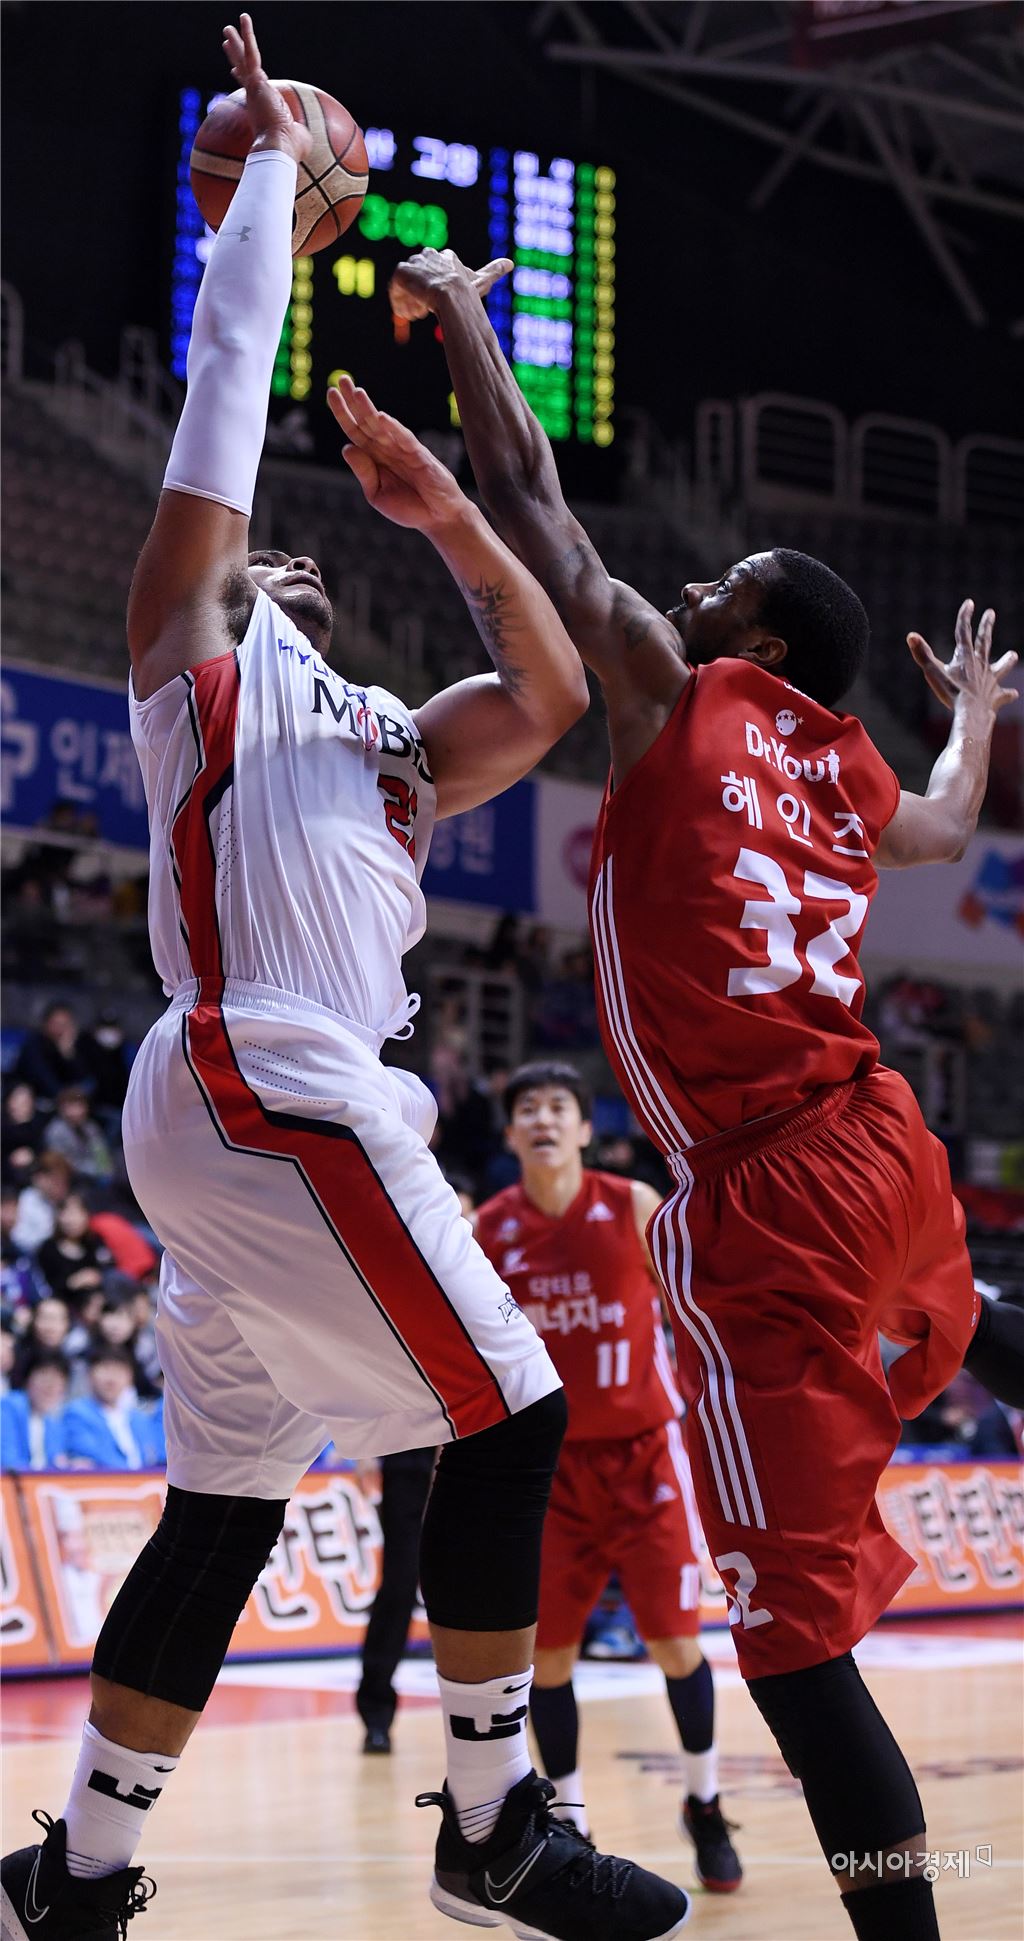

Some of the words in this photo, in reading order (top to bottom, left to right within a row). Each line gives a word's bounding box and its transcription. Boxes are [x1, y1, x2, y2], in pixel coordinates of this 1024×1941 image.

[745, 721, 826, 783] Dr.You
[727, 847, 869, 1008] 32
[596, 1340, 630, 1389] 11
